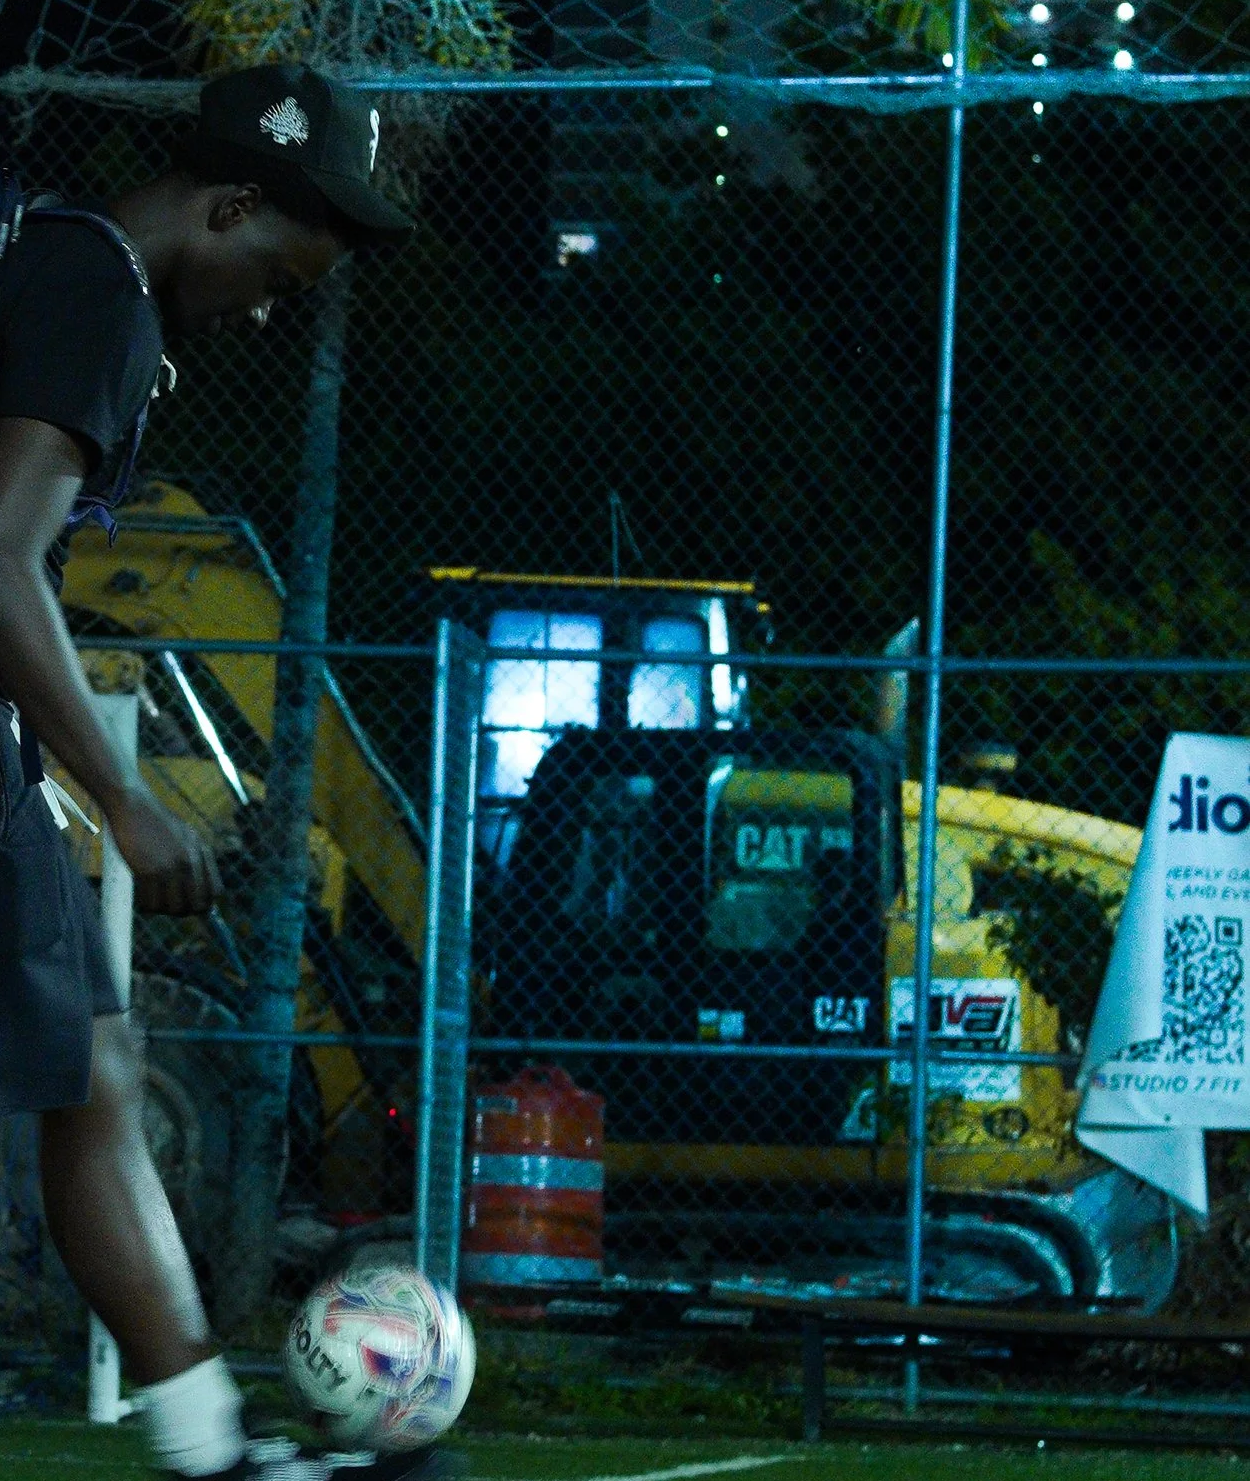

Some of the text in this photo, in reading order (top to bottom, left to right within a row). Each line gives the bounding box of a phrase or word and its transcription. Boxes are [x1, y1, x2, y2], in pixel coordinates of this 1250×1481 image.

[735, 822, 809, 870] CAT
[813, 995, 871, 1033] CAT
[1109, 1072, 1189, 1094] STUDIO
[1209, 1075, 1243, 1095] FIT
